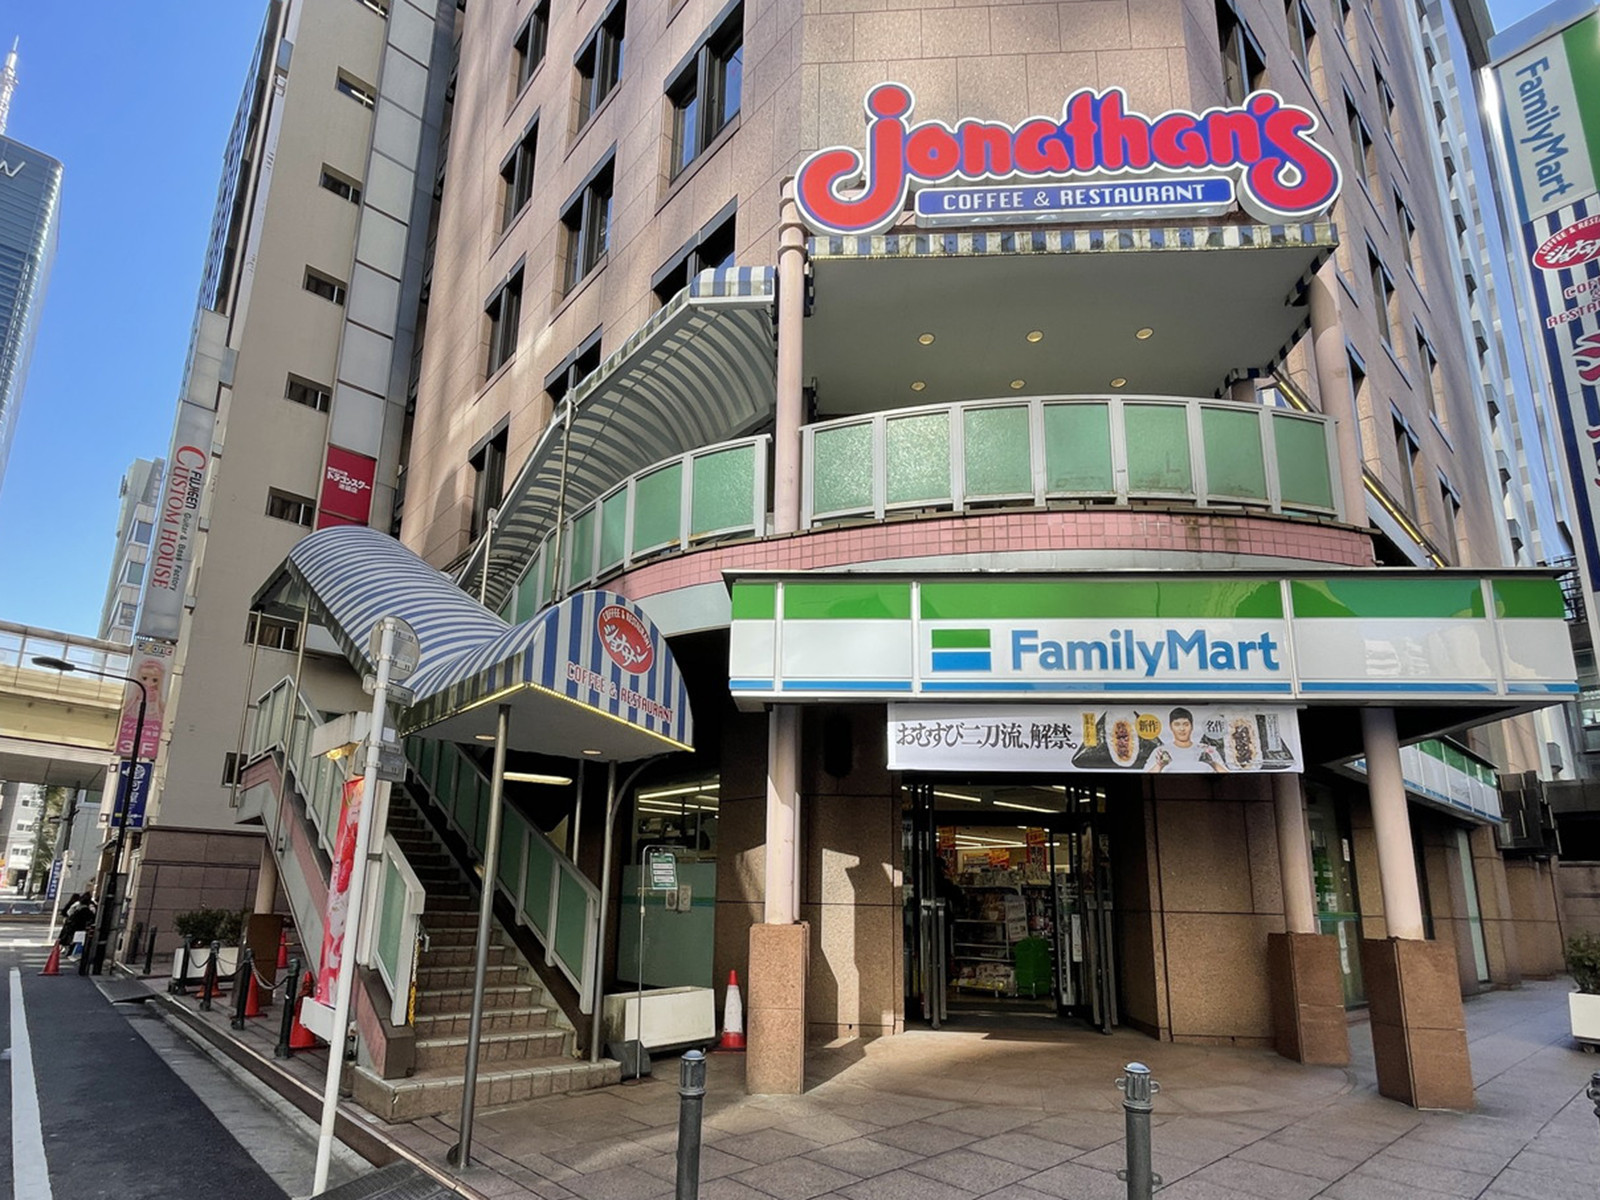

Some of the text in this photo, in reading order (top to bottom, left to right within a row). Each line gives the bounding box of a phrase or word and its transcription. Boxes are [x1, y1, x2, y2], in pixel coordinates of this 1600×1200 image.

[1515, 56, 1575, 203] FamilyMart
[942, 183, 1206, 210] COFFEE & RESTAURANT
[1539, 231, 1568, 255] COFFEE
[1569, 227, 1577, 235] &
[1564, 277, 1600, 299] COF
[1547, 300, 1600, 329] RESTA
[152, 445, 206, 590] CUSTOM HOUSE
[169, 565, 183, 591] Factory
[1012, 628, 1279, 677] FamilyMart
[566, 661, 673, 724] COFFEE & RESTAURANT
[897, 722, 1078, 749] おむすび二刀流、解禁。
[1138, 719, 1159, 733] 新作
[1205, 719, 1225, 734] 名作
